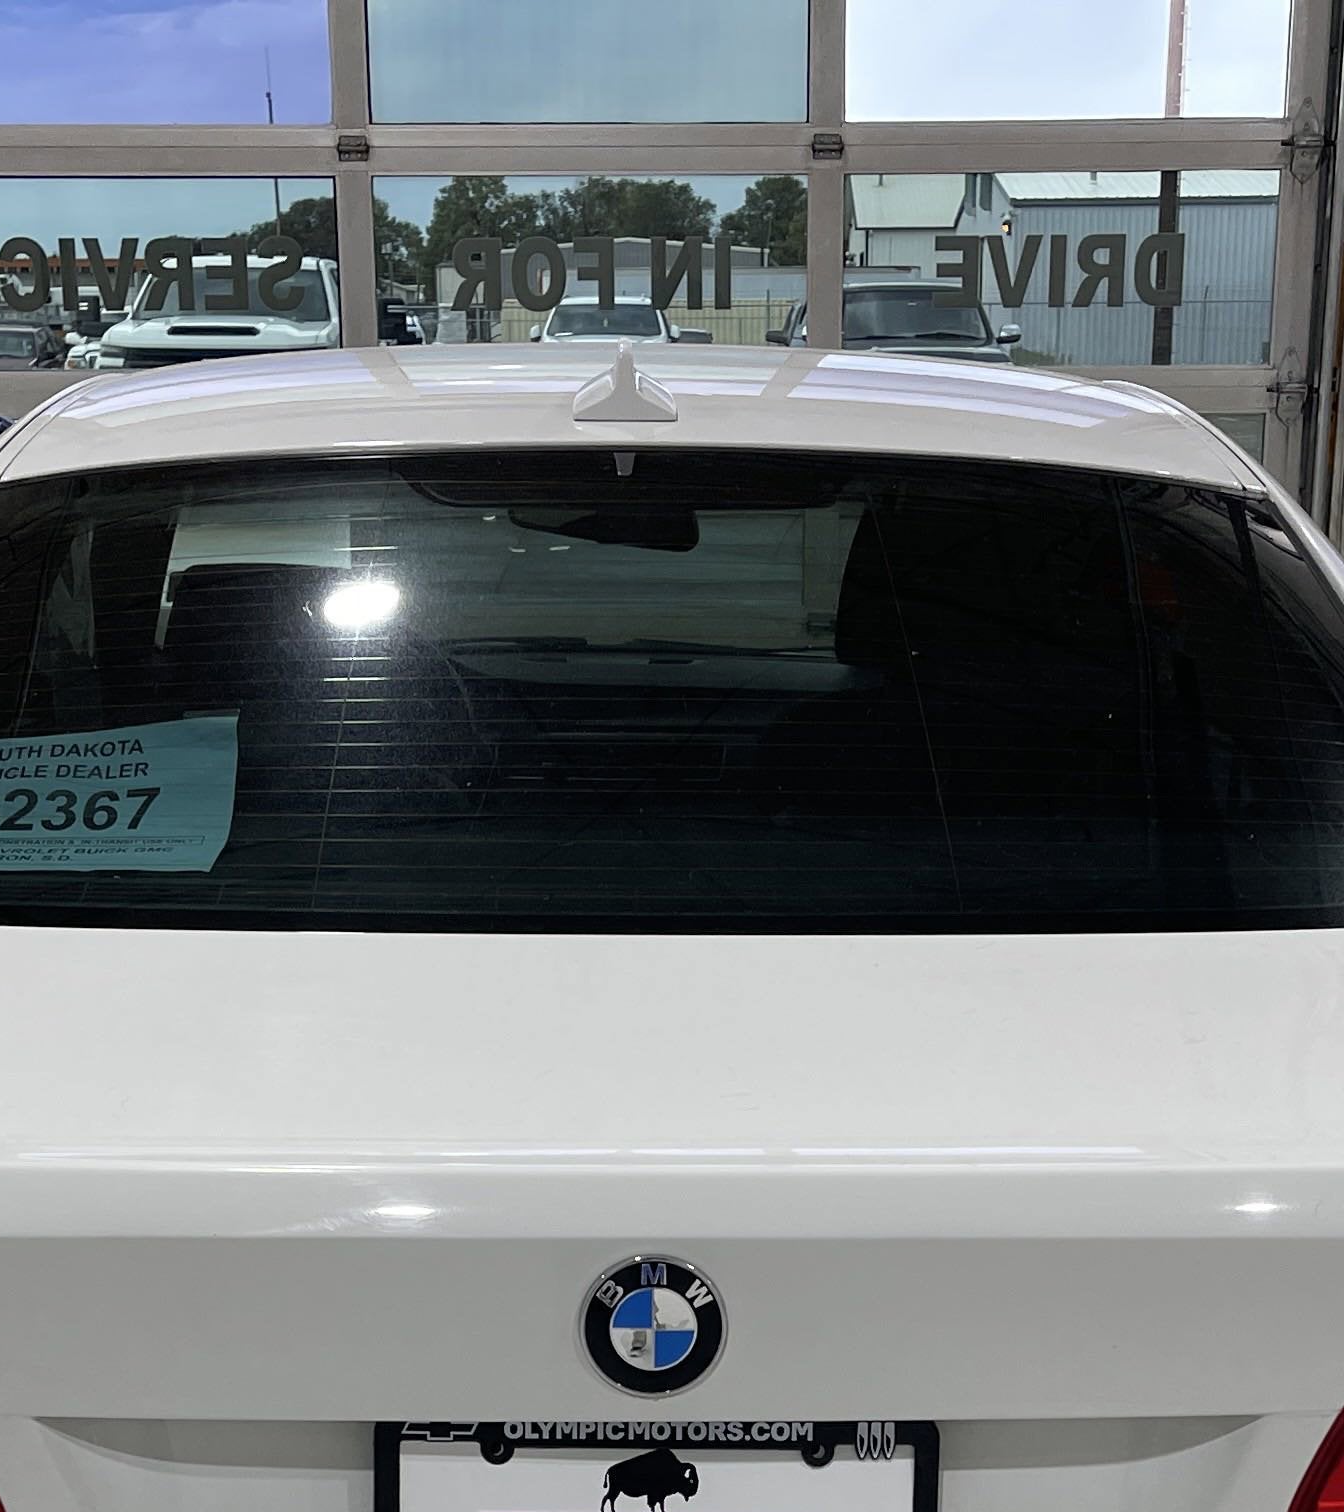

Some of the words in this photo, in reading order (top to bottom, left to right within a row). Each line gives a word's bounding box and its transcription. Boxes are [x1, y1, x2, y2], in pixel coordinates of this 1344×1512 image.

[49, 738, 145, 758] DAKOTA
[55, 761, 150, 780] DEALER
[73, 847, 129, 855] BUICK
[596, 1263, 713, 1309] BMW
[503, 1421, 814, 1441] OLYMPICMOTORS.COM
